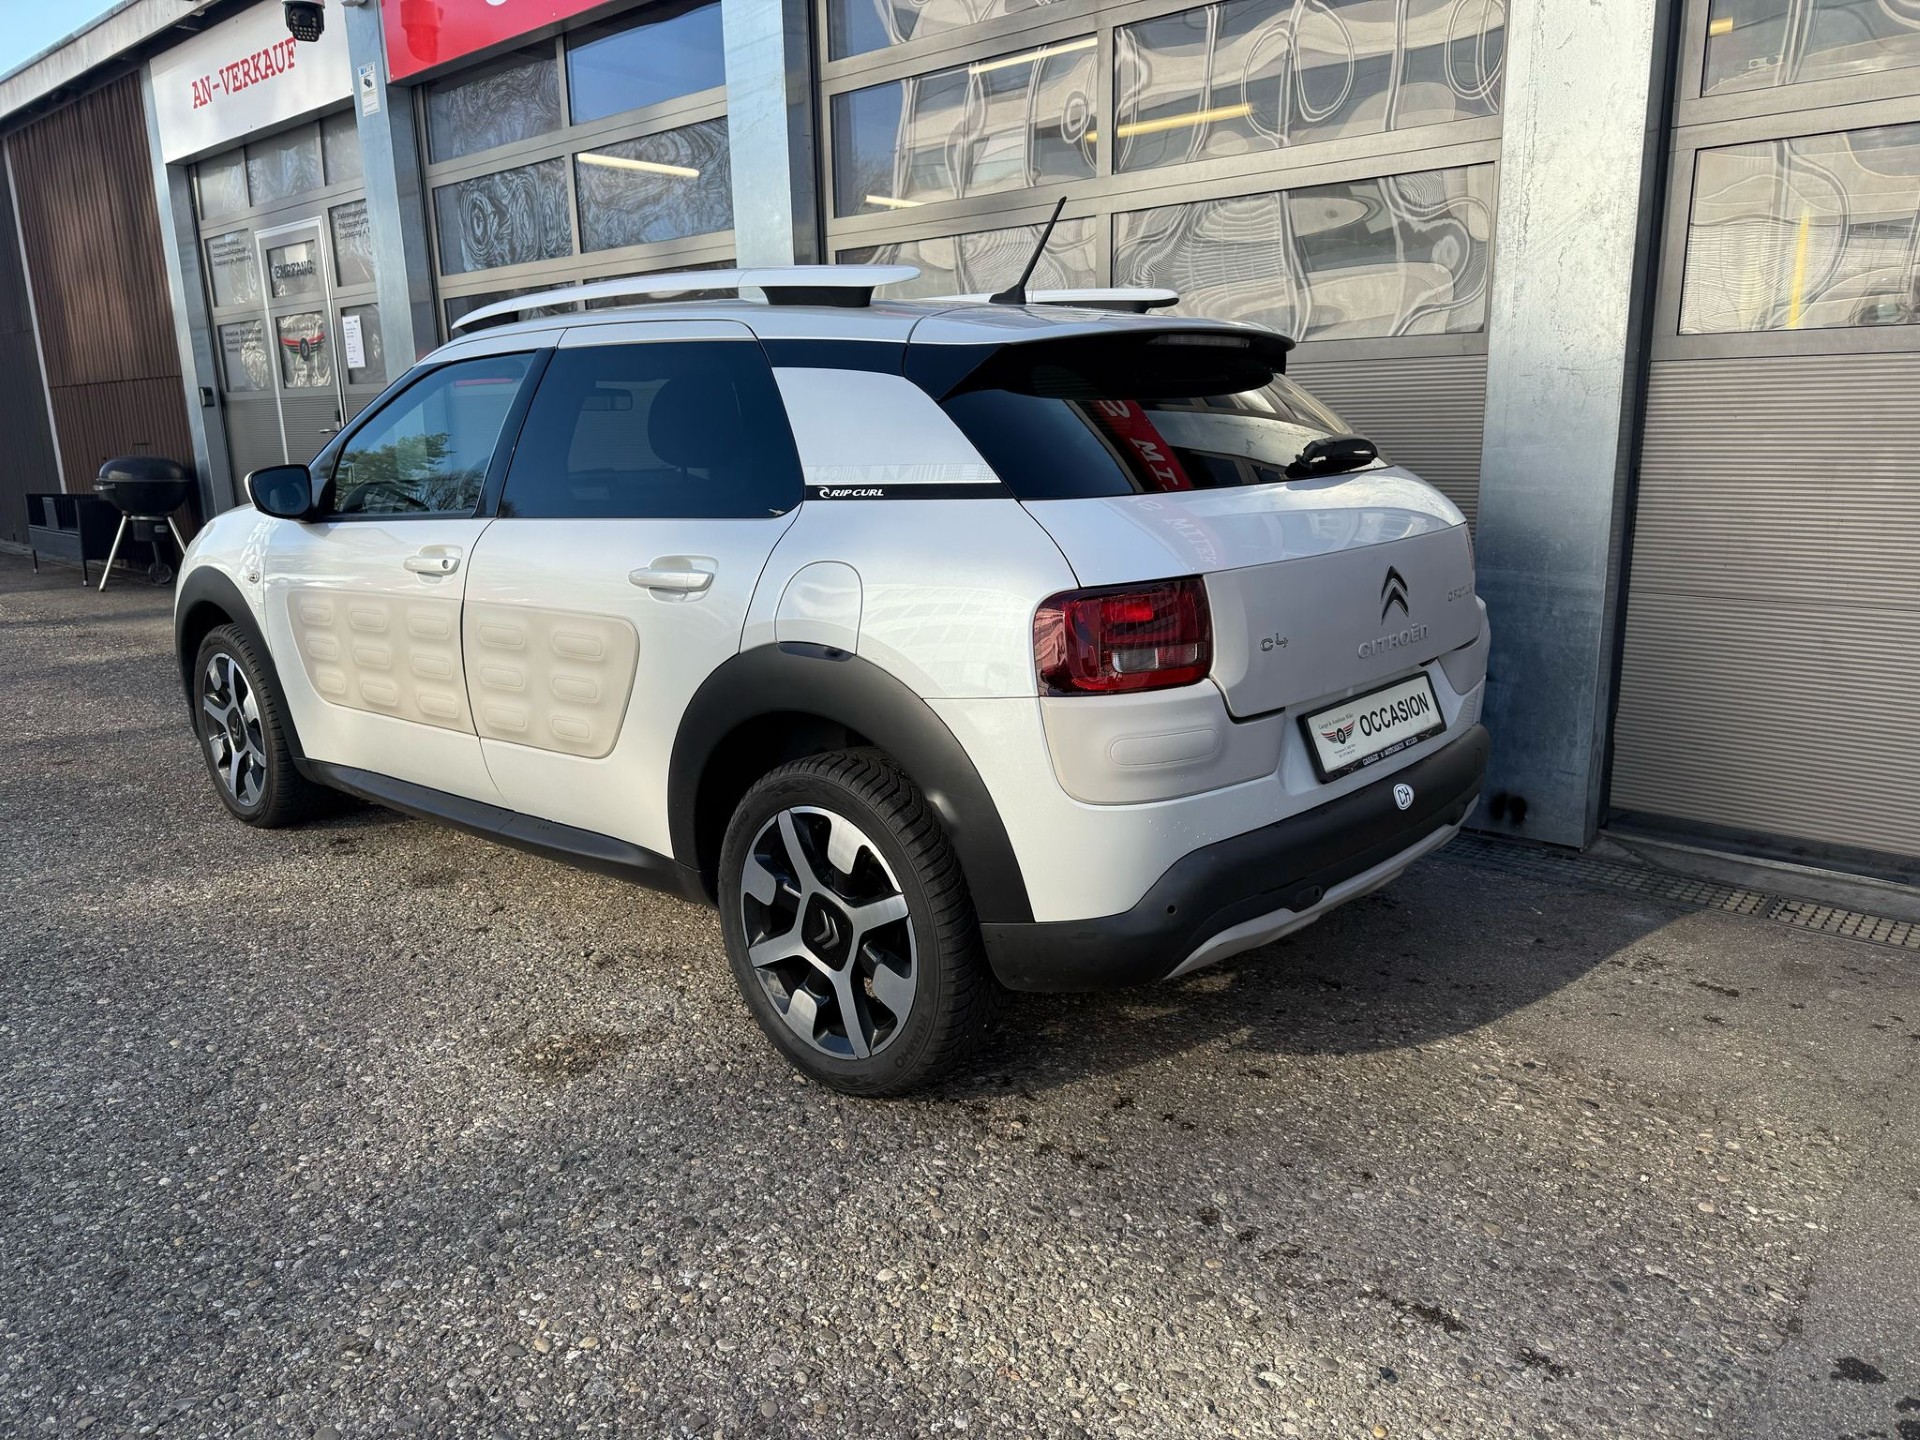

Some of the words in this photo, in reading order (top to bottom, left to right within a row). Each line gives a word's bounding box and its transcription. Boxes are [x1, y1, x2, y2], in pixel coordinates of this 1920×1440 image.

[192, 36, 296, 109] AN-VERKAUF
[1260, 632, 1288, 651] C4
[1359, 692, 1430, 737] OCCASION
[1398, 786, 1411, 805] CH
